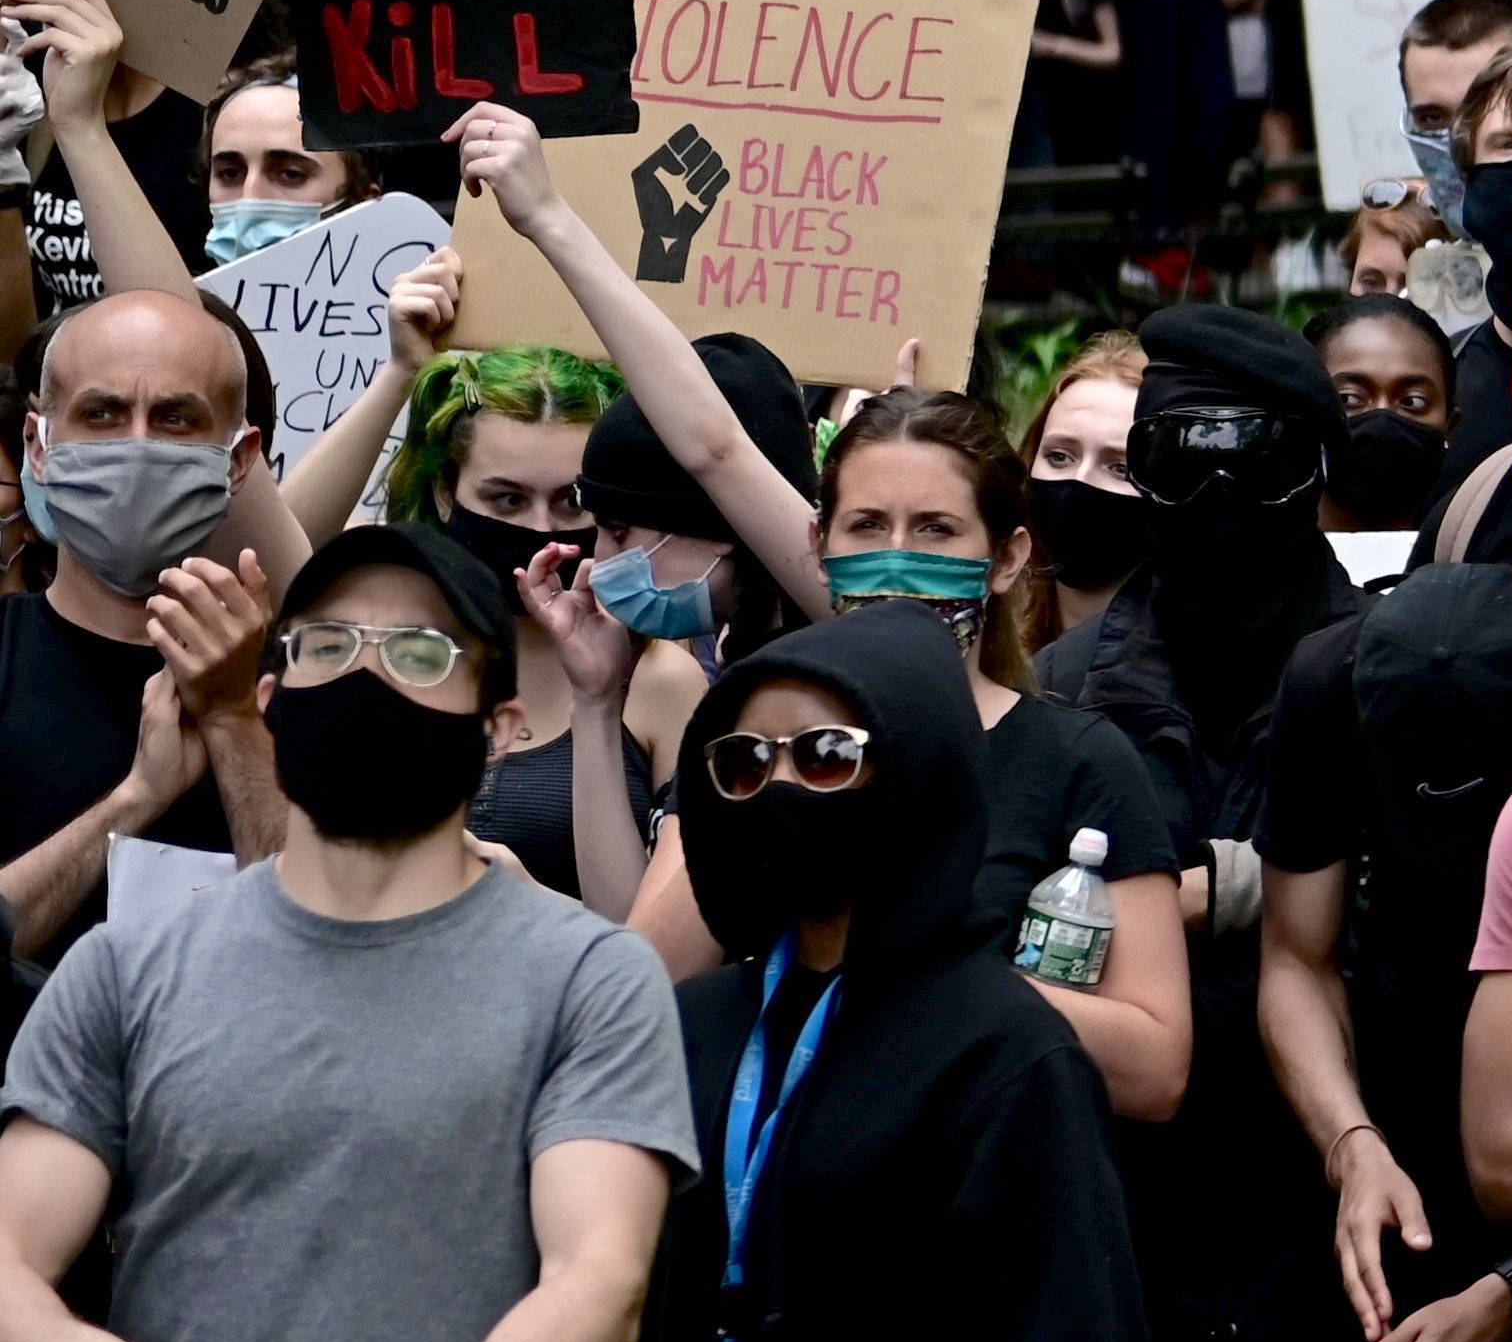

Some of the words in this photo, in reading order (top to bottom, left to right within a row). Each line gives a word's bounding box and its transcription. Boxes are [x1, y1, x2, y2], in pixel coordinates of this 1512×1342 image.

[738, 138, 888, 207] BLACK
[716, 208, 853, 256] LIVES
[697, 255, 902, 326] MATTER
